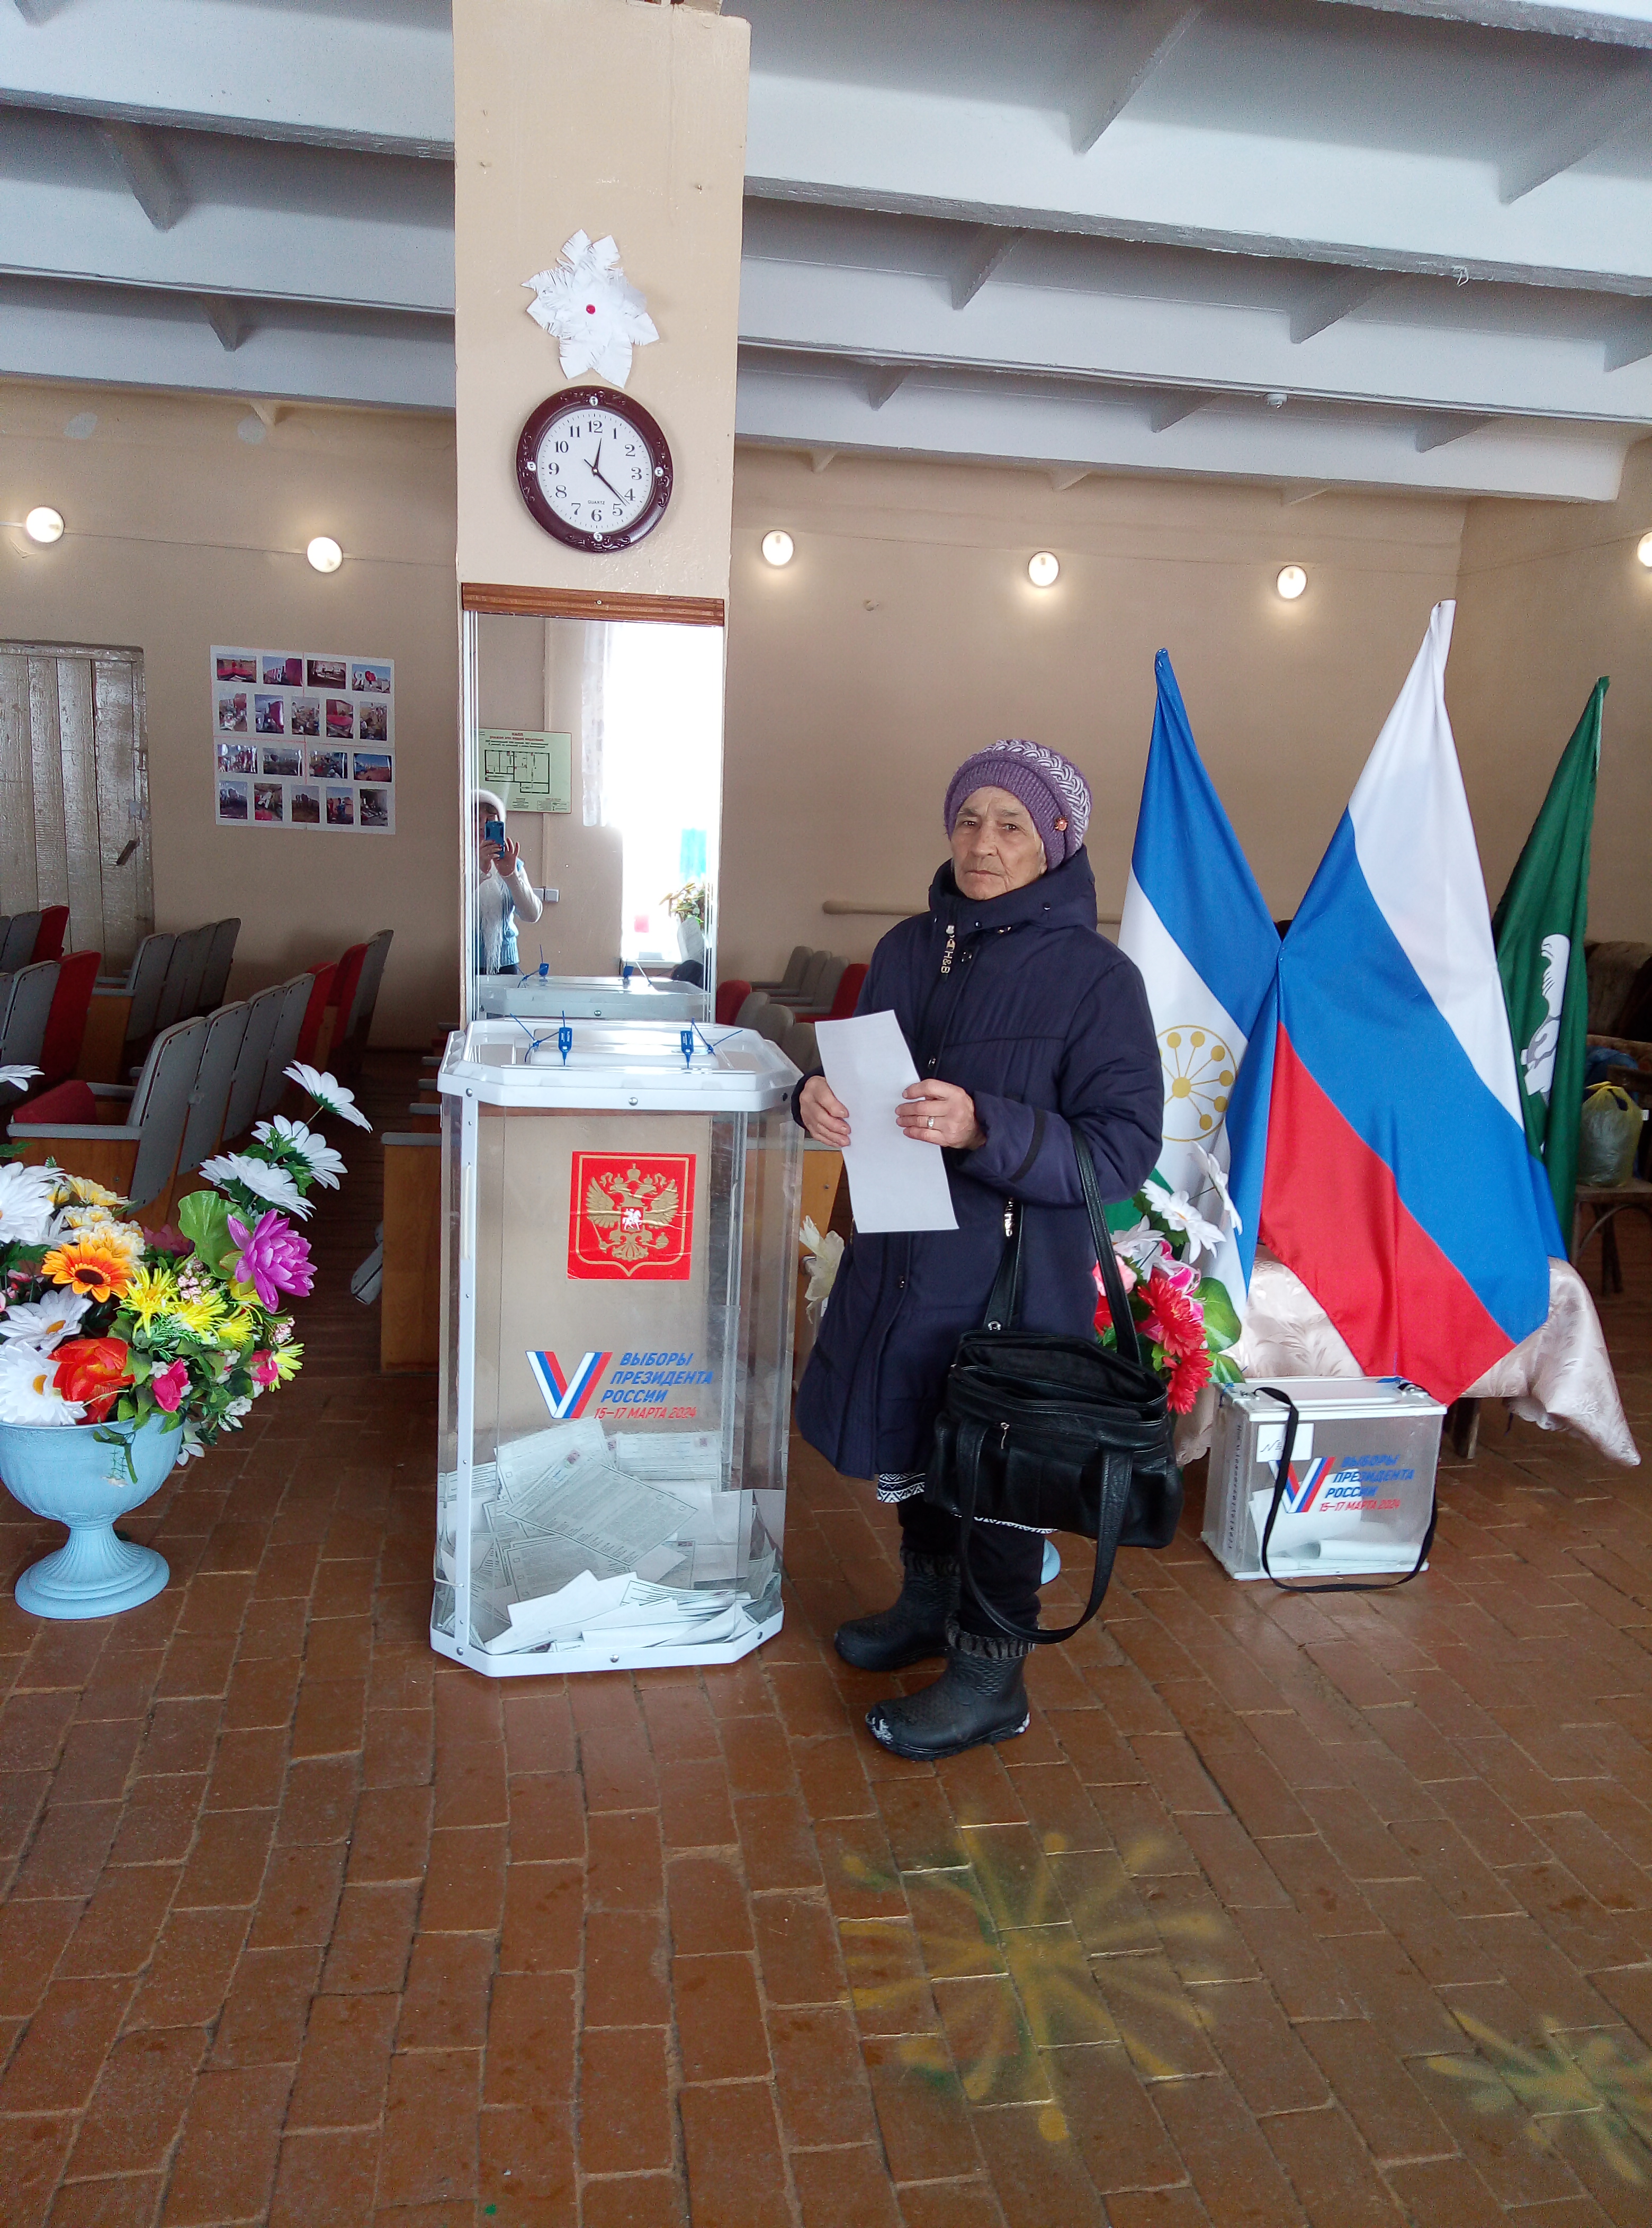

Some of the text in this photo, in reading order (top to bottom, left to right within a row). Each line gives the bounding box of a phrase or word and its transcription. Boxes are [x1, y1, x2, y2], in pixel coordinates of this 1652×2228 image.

[569, 425, 581, 438] 11
[587, 420, 603, 433] 12
[612, 427, 617, 439] 1
[554, 441, 569, 453] 10
[625, 444, 636, 457] 2
[548, 463, 559, 475] 9
[631, 467, 642, 480] 3
[555, 485, 567, 499] 8
[624, 488, 636, 501] 4
[571, 502, 581, 515] 7
[612, 504, 623, 516] 5
[591, 509, 602, 522] 6
[941, 951, 954, 973] H&B
[620, 1352, 694, 1366] ВЫБОРЫ
[609, 1370, 714, 1386] ПРЕЗИДЕНТА
[600, 1389, 668, 1403] РОССИИ
[627, 1407, 667, 1419] МАРТА
[668, 1406, 697, 1419] 2024
